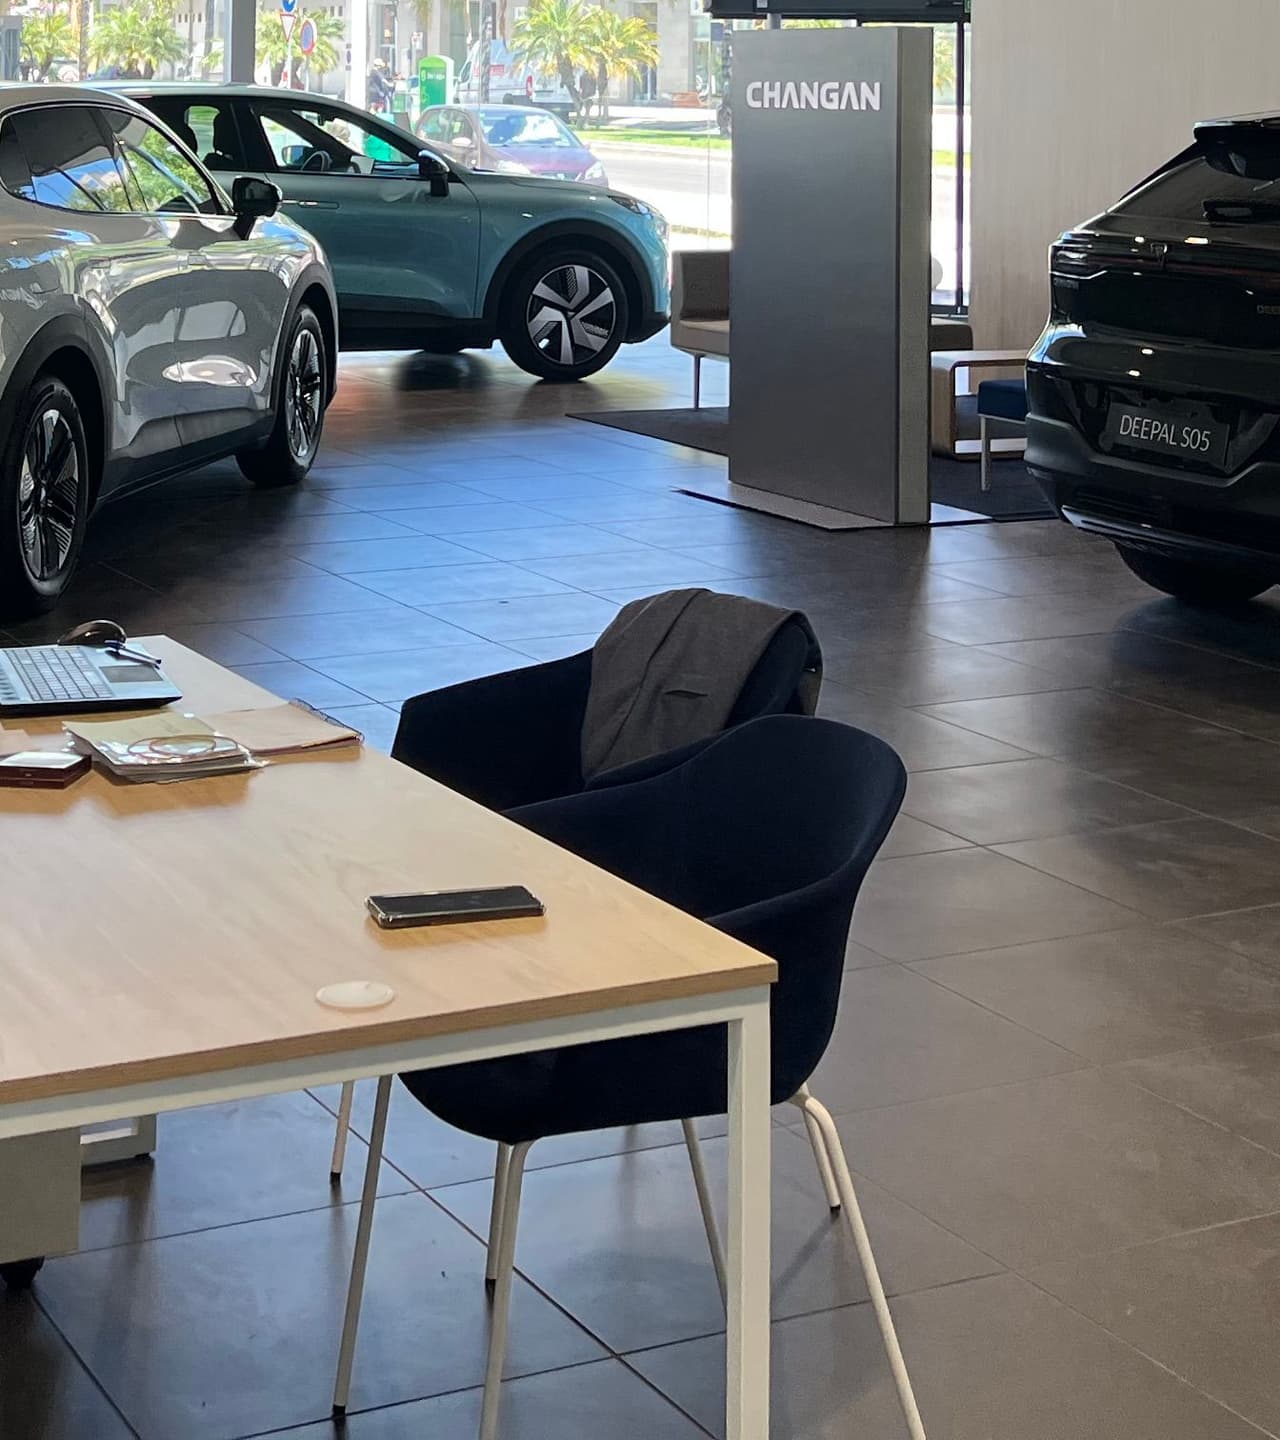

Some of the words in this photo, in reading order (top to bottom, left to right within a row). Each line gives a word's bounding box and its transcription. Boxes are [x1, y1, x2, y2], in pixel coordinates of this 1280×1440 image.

[746, 81, 881, 111] CHANGAN
[1119, 414, 1177, 446] DEEPAL
[1180, 426, 1211, 452] S05
